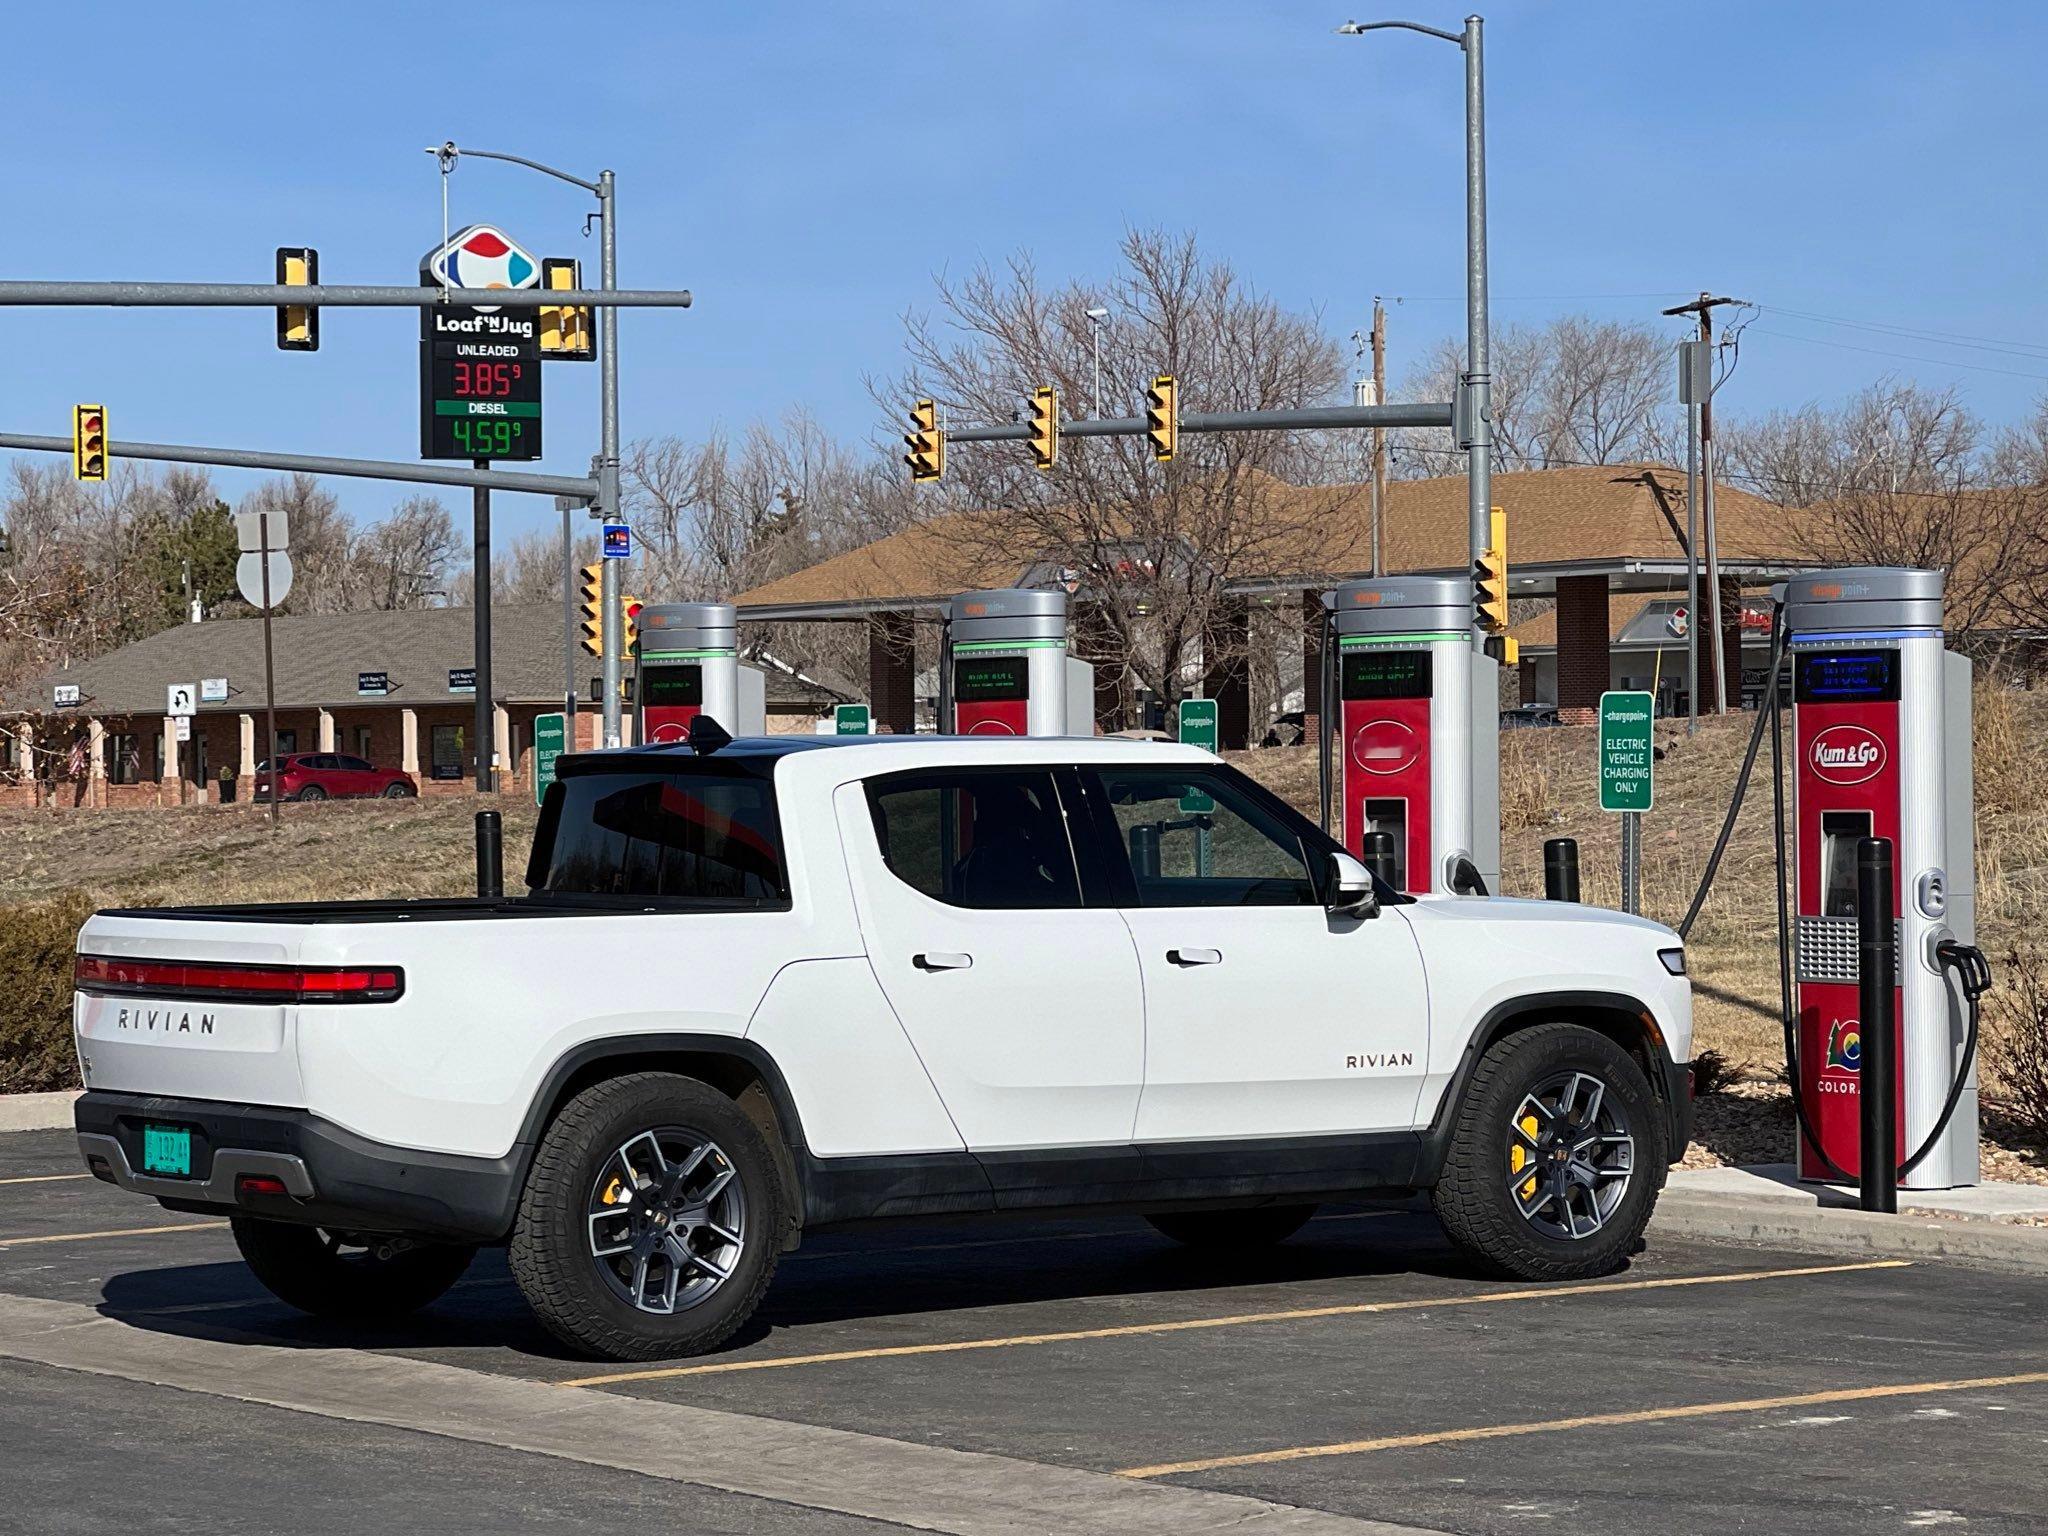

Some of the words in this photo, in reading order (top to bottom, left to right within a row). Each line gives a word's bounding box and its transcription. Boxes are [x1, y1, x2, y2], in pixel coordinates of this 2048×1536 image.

[436, 314, 483, 332] Loaf
[500, 316, 533, 338] Jug
[456, 344, 519, 357] UNLEADED
[468, 402, 508, 415] DIESEL
[1606, 739, 1647, 750] ELECTRIC
[1608, 753, 1645, 764] VEHICLE
[1815, 742, 1846, 764] Kum
[1847, 746, 1857, 762] &
[1858, 742, 1879, 765] Go
[1603, 768, 1650, 779] CHARGING
[1615, 782, 1639, 793] ONLY
[119, 1008, 215, 1034] RIVIAN
[1346, 1052, 1413, 1069] RIVIAN
[1817, 1080, 1861, 1095] COLOR
